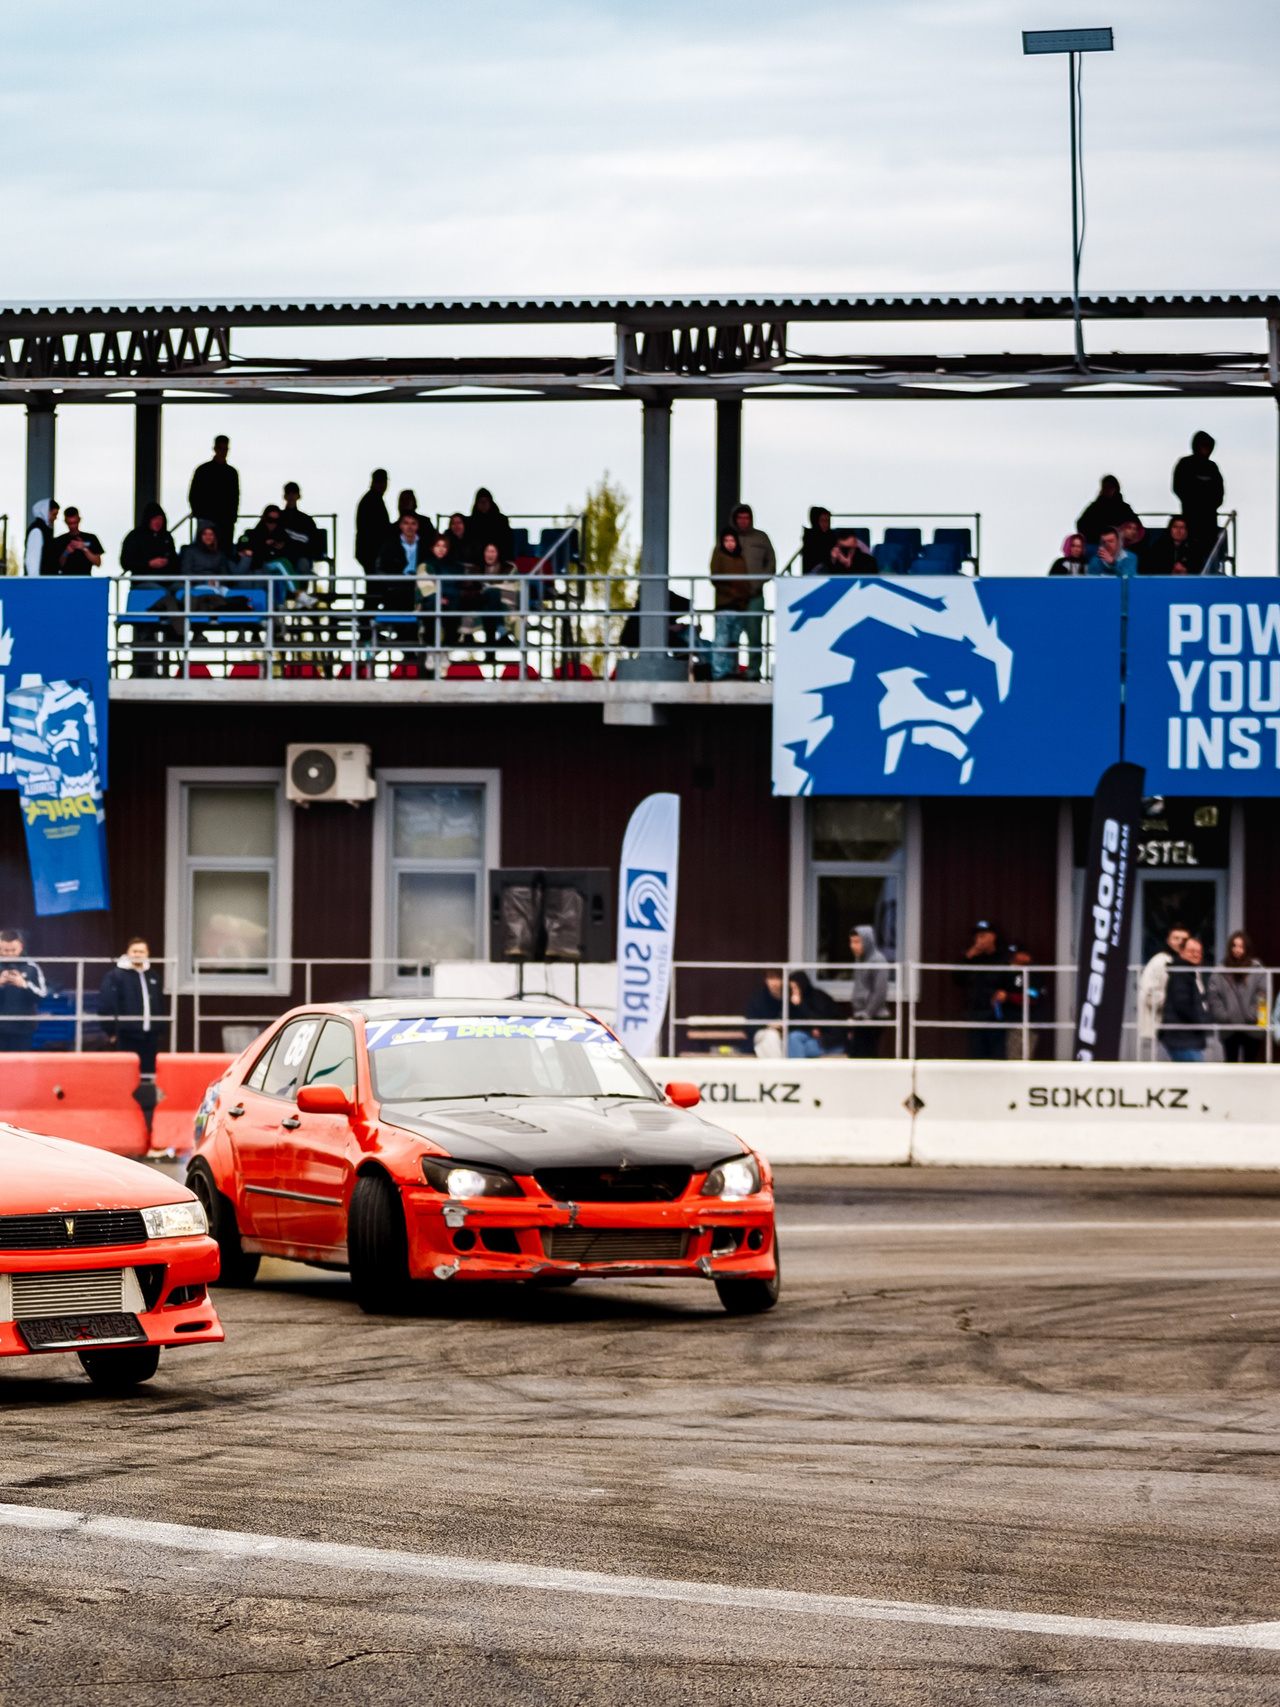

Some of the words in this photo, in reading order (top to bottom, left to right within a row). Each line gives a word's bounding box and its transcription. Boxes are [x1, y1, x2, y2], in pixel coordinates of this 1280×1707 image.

[1078, 818, 1120, 1046] Pandora
[1111, 823, 1131, 947] KAZAKHSTAN
[1028, 1086, 1189, 1109] SOKOL.KZ
